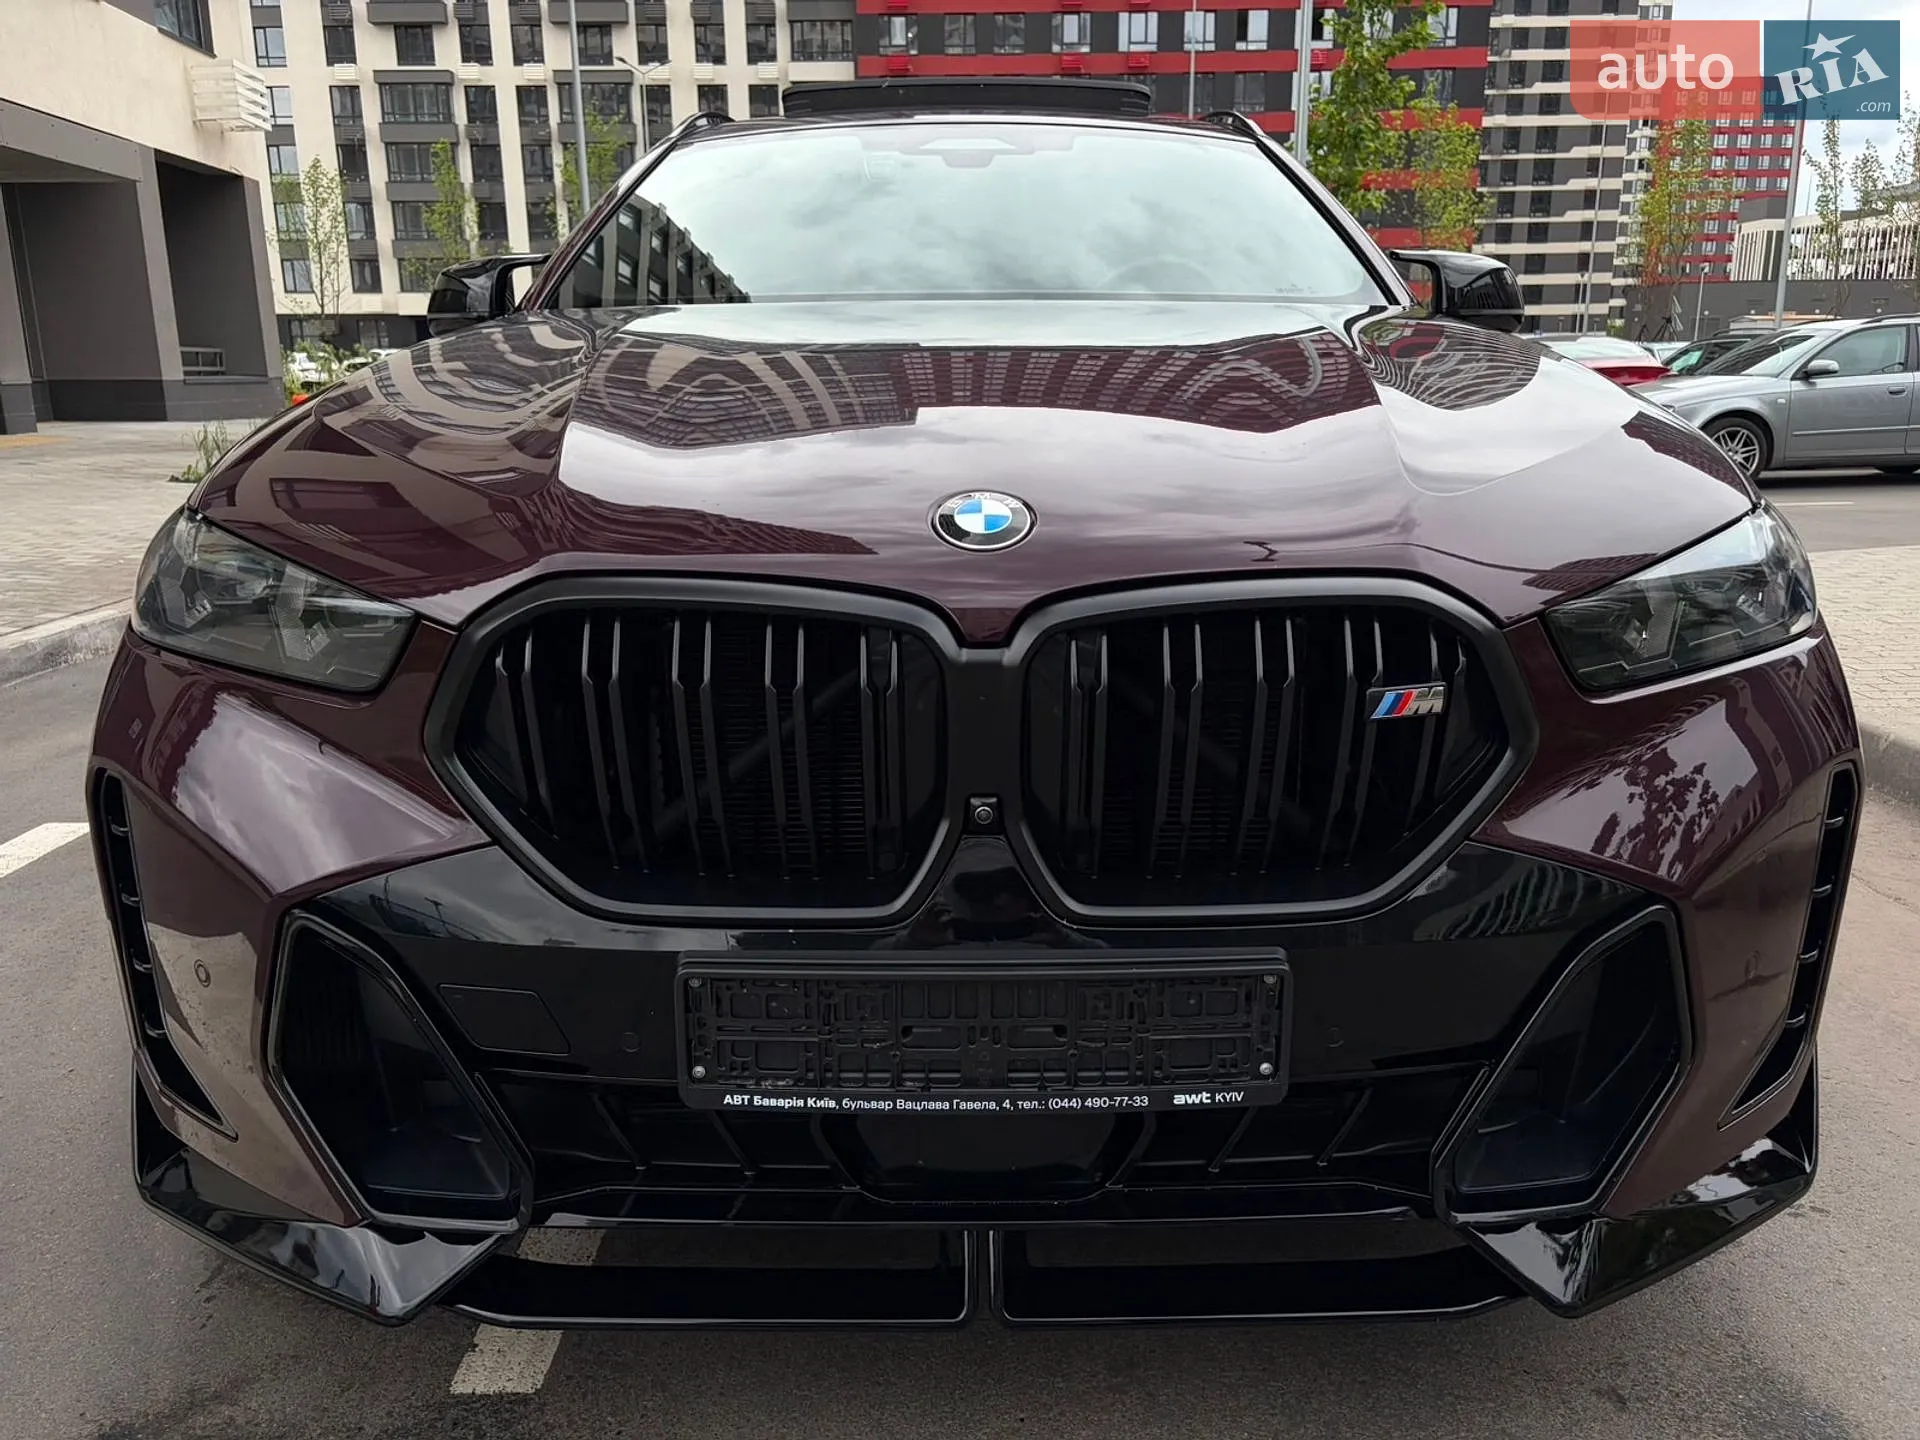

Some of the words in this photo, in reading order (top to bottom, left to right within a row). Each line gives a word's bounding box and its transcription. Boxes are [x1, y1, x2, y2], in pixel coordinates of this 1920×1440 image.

[753, 1095, 804, 1109] Баварія
[807, 1097, 839, 1109] Київ,
[842, 1098, 893, 1111] бульвар
[896, 1099, 950, 1111] Вацлава
[953, 1099, 1000, 1111] Гавела,
[1002, 1099, 1014, 1110] 4,
[1017, 1099, 1046, 1110] тел.:
[1048, 1098, 1082, 1110] (044)
[1085, 1096, 1149, 1108] 490-77-33
[1173, 1091, 1211, 1105] awt
[1215, 1091, 1245, 1102] KYIV
